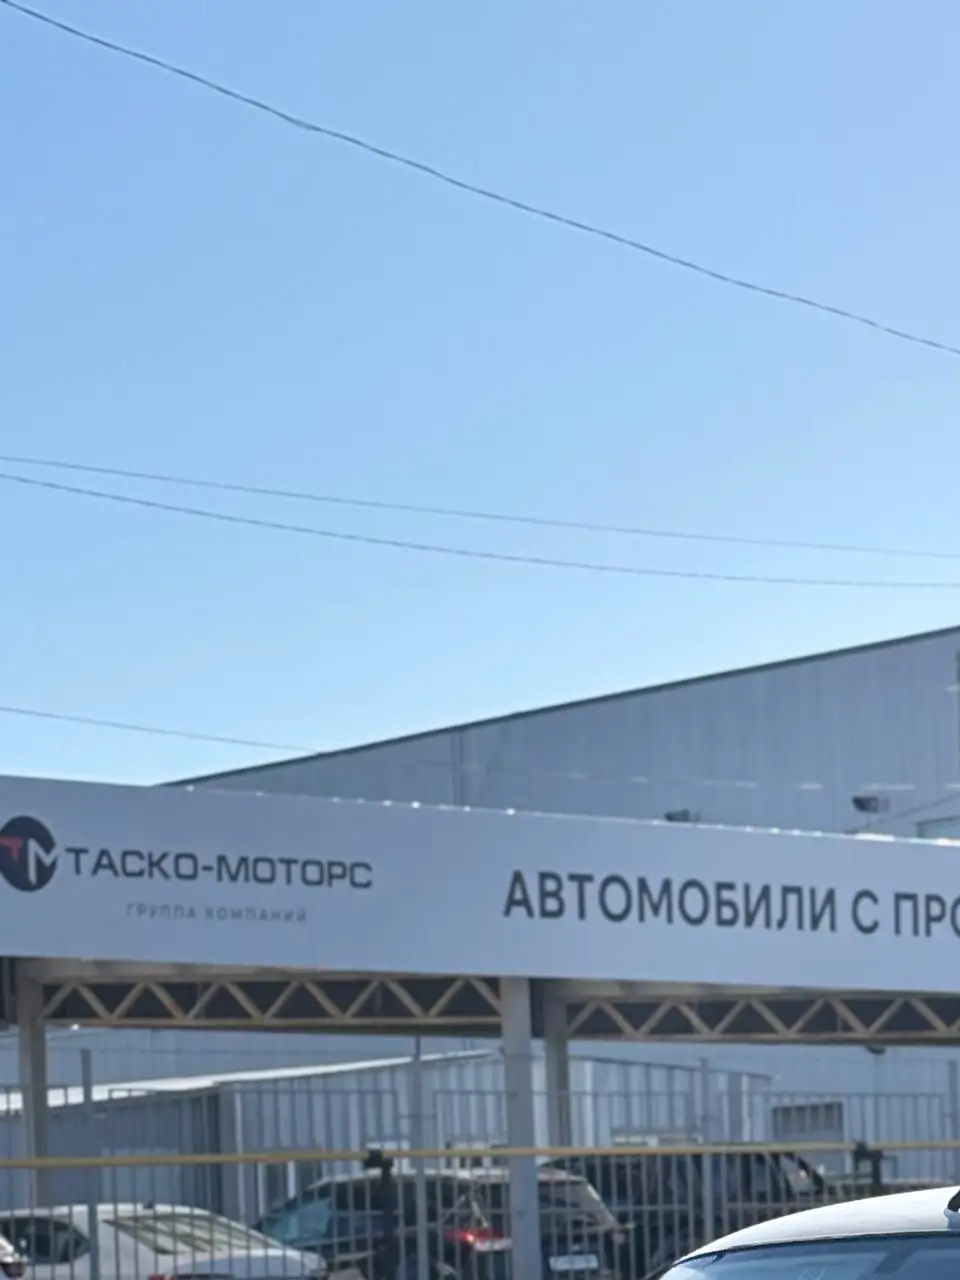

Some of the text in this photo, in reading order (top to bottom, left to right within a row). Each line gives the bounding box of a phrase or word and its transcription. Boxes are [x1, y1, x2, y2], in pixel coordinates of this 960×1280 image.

[65, 847, 374, 890] ТАСКО-МОТОРС
[502, 868, 838, 934] АВТОМОБИЛИ
[850, 888, 881, 935] С
